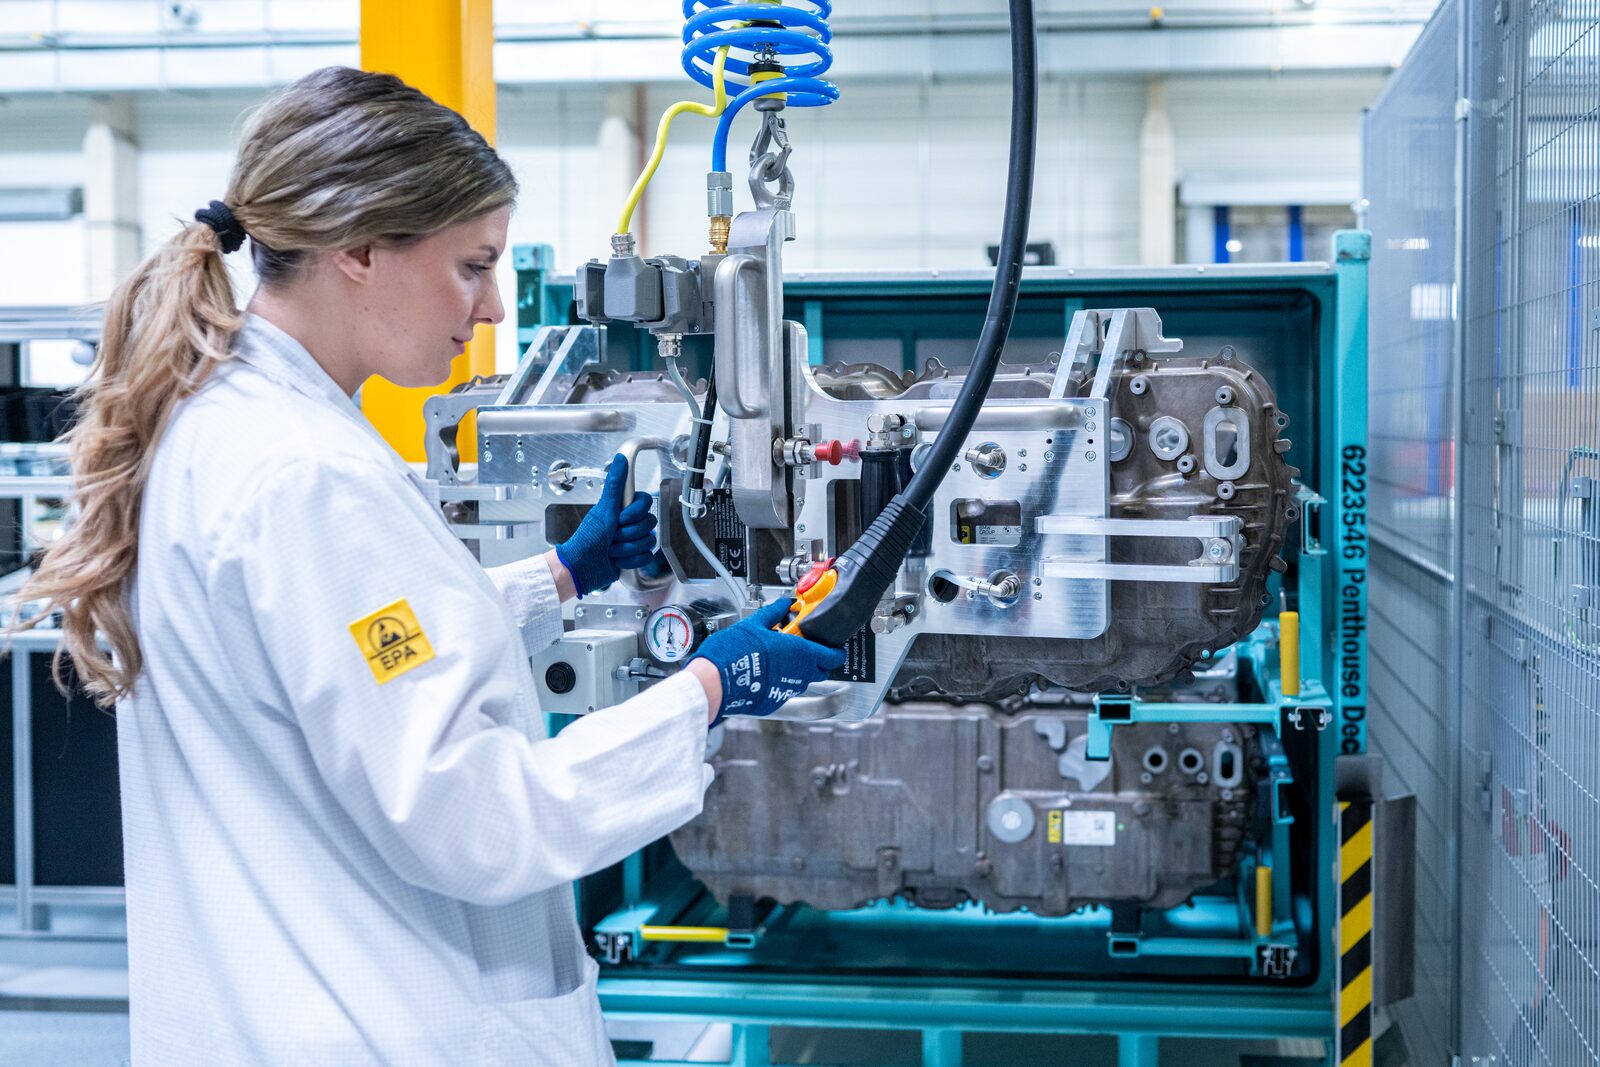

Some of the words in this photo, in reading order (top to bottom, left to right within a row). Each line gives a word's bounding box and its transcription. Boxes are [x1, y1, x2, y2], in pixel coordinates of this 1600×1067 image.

[1342, 445, 1366, 559] 6223546
[380, 644, 417, 671] EPA
[1342, 569, 1365, 697] Penthouse
